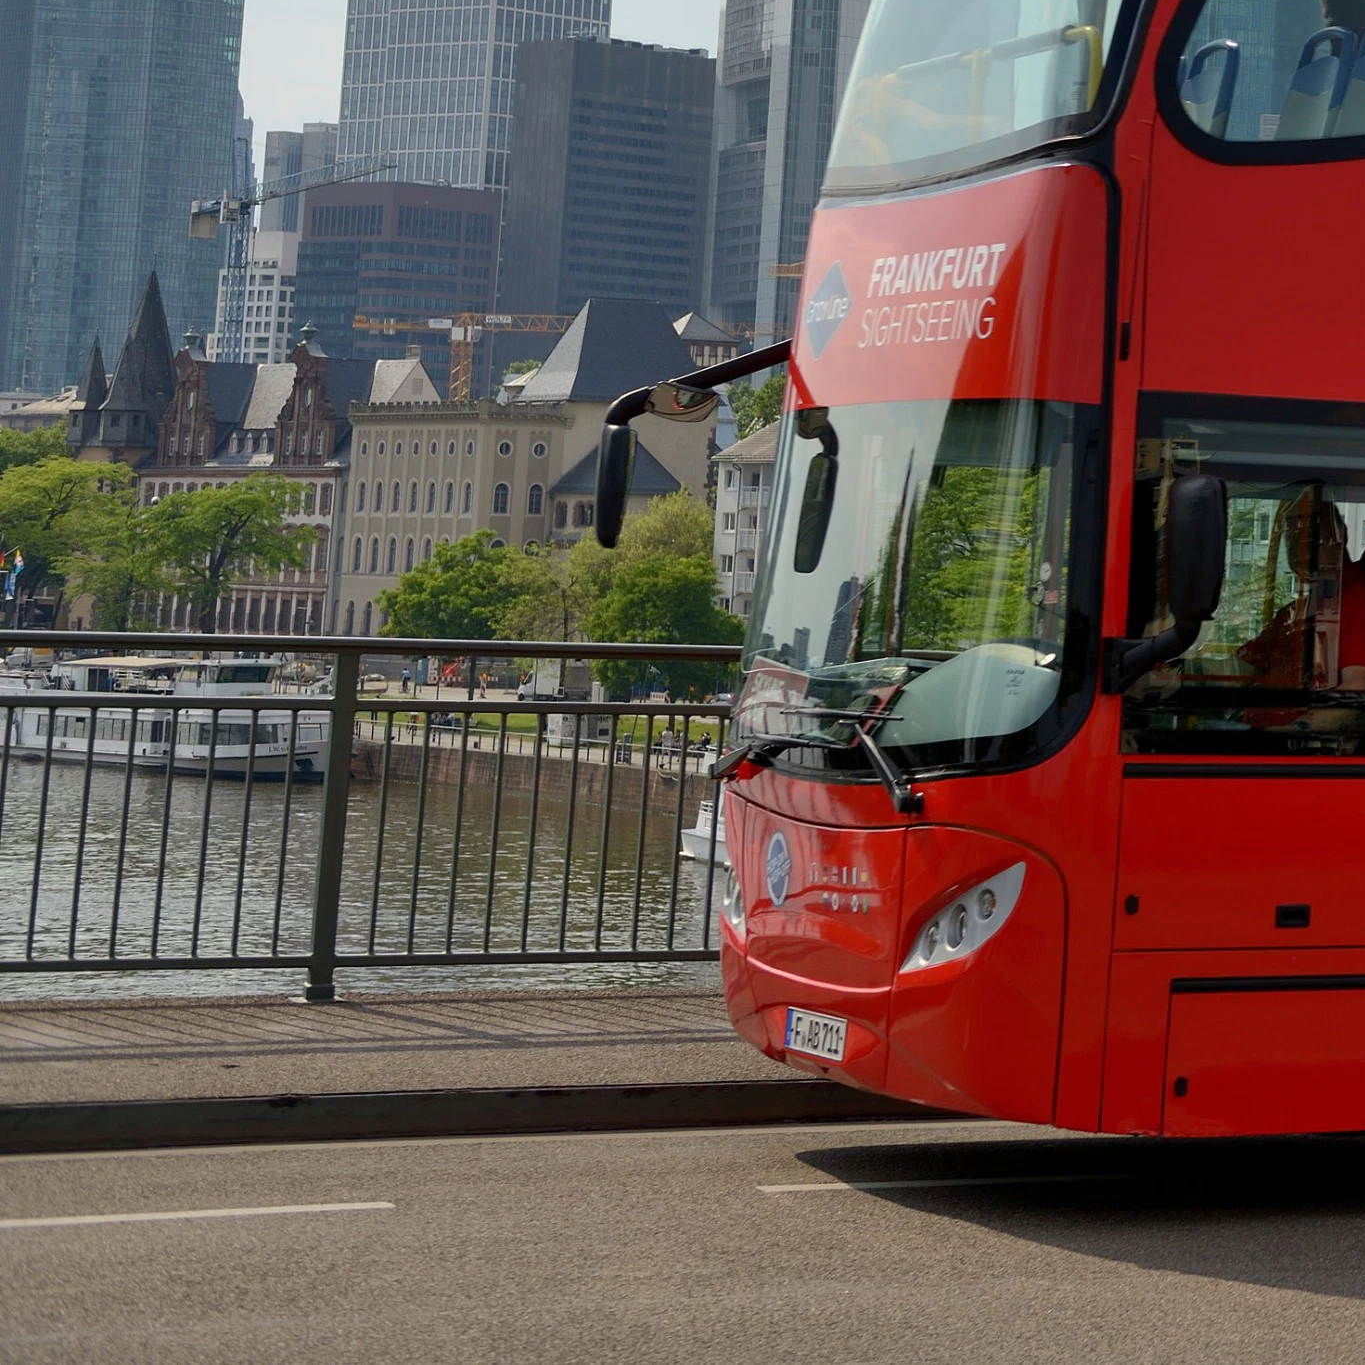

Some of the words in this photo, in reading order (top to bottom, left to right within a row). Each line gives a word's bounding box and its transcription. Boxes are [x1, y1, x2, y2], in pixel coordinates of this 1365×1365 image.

[866, 243, 1006, 299] FRANKFURT
[858, 296, 996, 349] SIGHTSEEING
[794, 1016, 802, 1045] F
[807, 1019, 820, 1050] AB
[823, 1022, 840, 1054] 711
